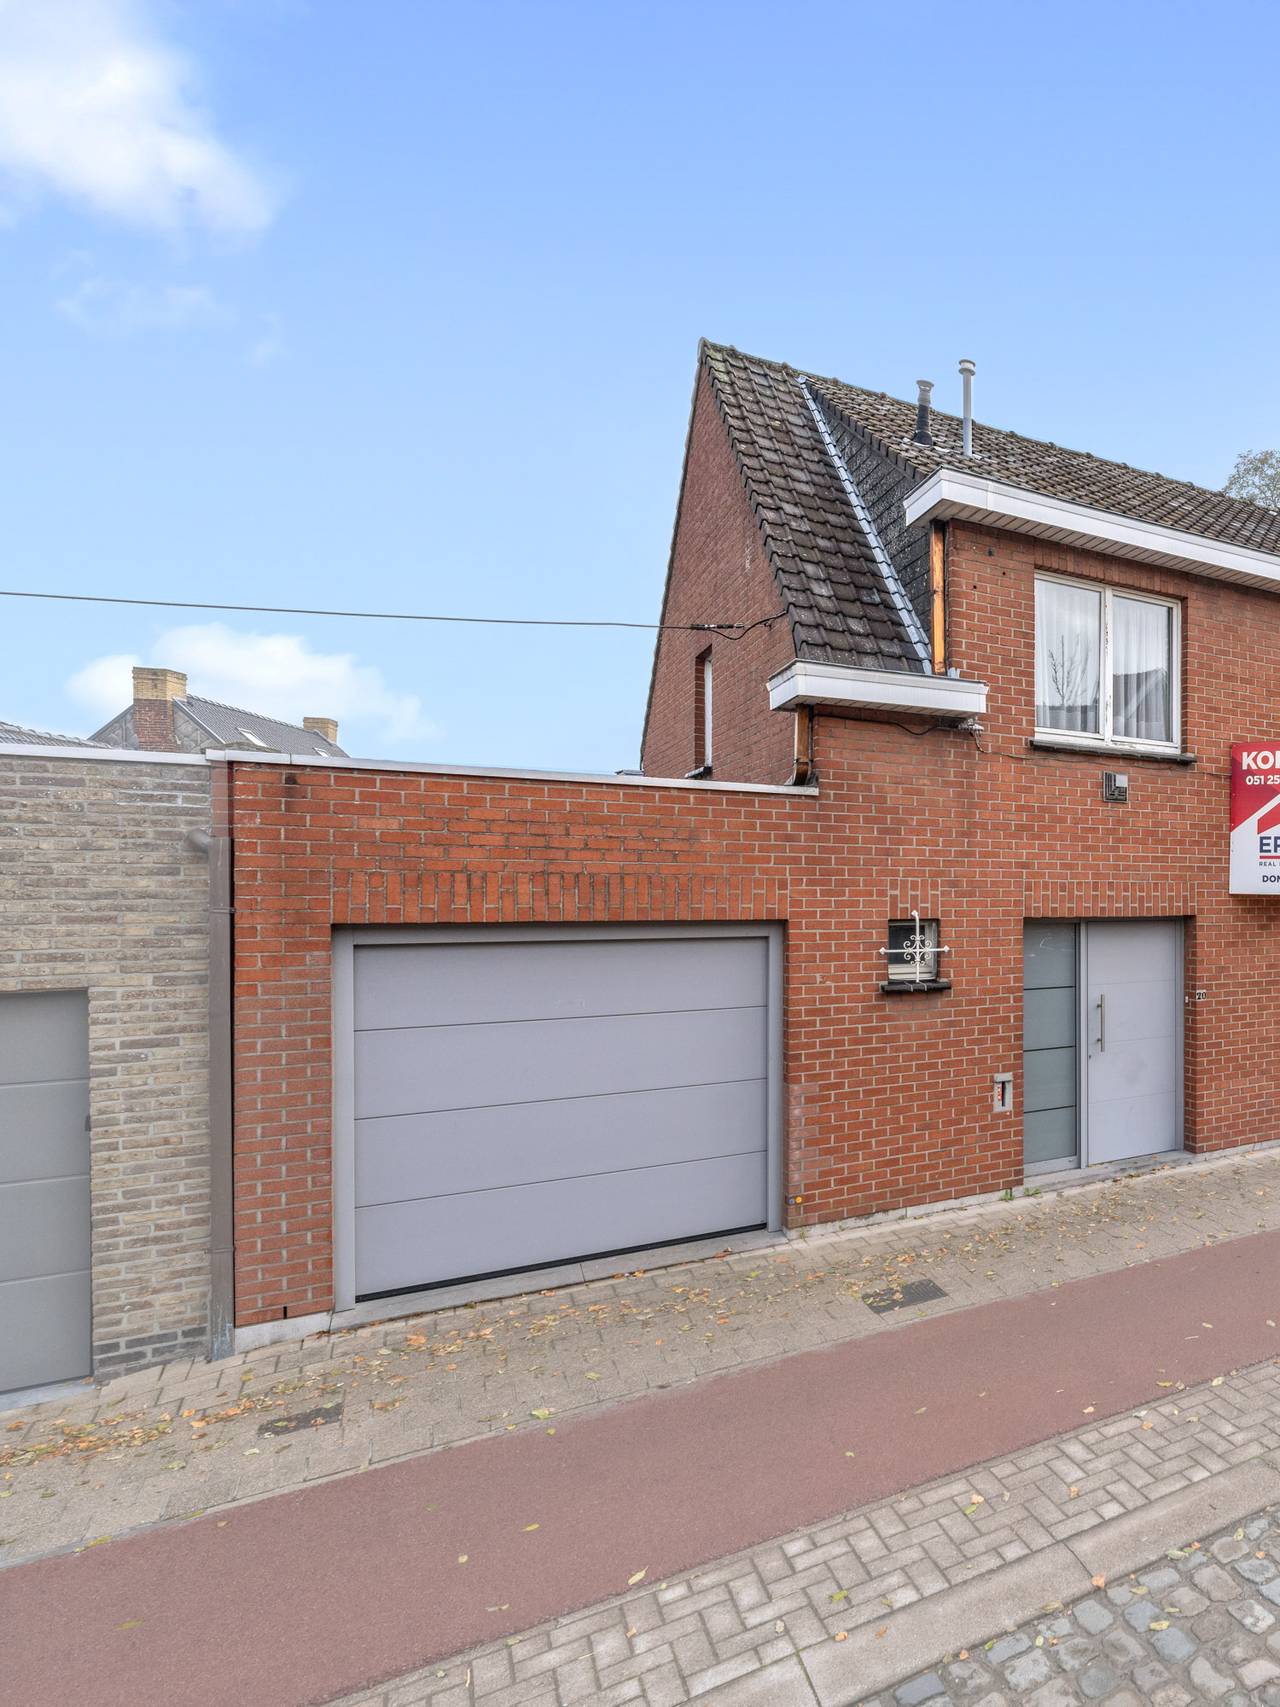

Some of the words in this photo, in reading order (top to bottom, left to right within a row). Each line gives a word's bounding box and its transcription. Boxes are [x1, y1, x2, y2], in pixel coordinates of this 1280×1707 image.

[1246, 775, 1265, 785] 051
[1266, 775, 1280, 785] 25
[1196, 991, 1207, 1000] 20
